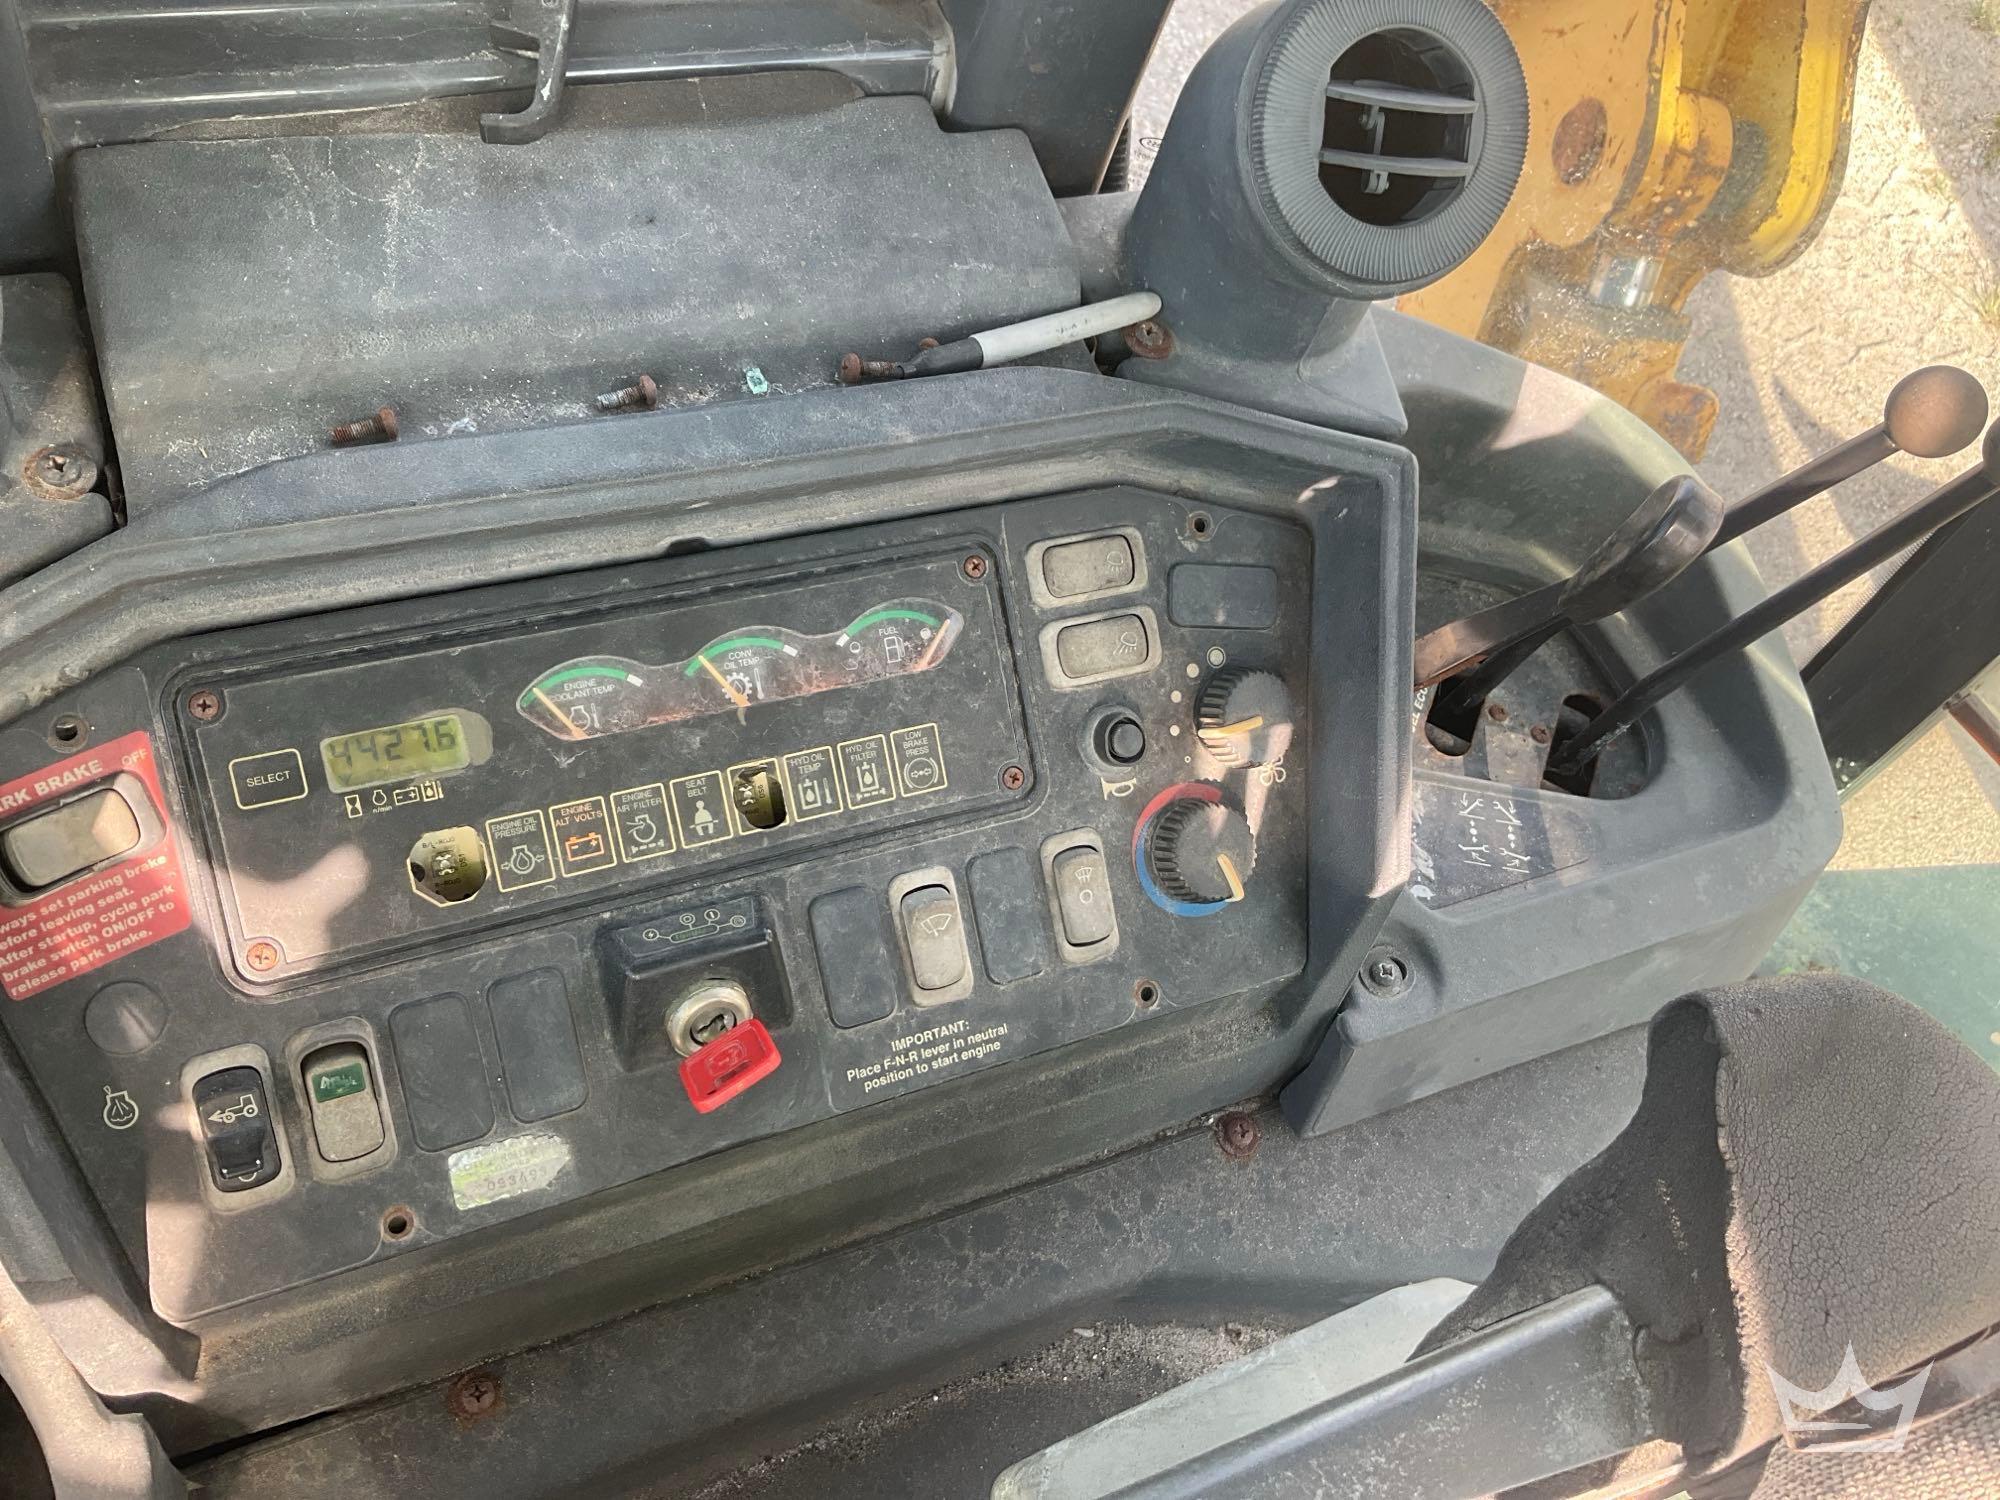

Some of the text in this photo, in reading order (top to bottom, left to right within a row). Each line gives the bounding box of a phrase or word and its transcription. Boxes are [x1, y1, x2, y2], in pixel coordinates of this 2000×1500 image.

[879, 626, 899, 636] FUEL
[728, 649, 752, 660] CONV
[724, 656, 760, 670] OIL TEMP
[563, 678, 597, 690] ENGINE
[551, 684, 616, 702] COOLANT TEMP
[905, 730, 922, 740] LOW
[846, 740, 878, 754] HYD OIL
[903, 737, 929, 749] BRAKE
[121, 748, 148, 766] OFF
[850, 750, 877, 762] FILTER
[905, 746, 930, 757] PRESS
[790, 752, 825, 767] HYD OIL
[798, 762, 822, 774] TEMP
[33, 759, 103, 796] BRAKE
[246, 770, 291, 787] SELECT
[685, 778, 706, 788] SEAT
[622, 790, 653, 803] ENGINE
[687, 787, 708, 798] BELT
[560, 803, 593, 816] ENGINE
[616, 797, 663, 814] AIR FILTER
[491, 816, 537, 831] ENGINE OIL
[555, 810, 603, 827] ALT VOLTS
[494, 824, 537, 839] PRESSURE
[40, 898, 64, 916] set
[67, 873, 124, 906] parking
[125, 855, 167, 879] brake
[40, 902, 95, 932] leaving
[97, 887, 135, 907] seat.
[0, 882, 175, 967] After startup, cycle park
[2, 901, 175, 982] brake switch ON/OFF to
[10, 928, 153, 996] release park brake.
[891, 1020, 970, 1052] IMPORTANT:
[846, 1023, 1008, 1082] Place F-N-R lever in neutral
[864, 1041, 1001, 1093] position to start engine
